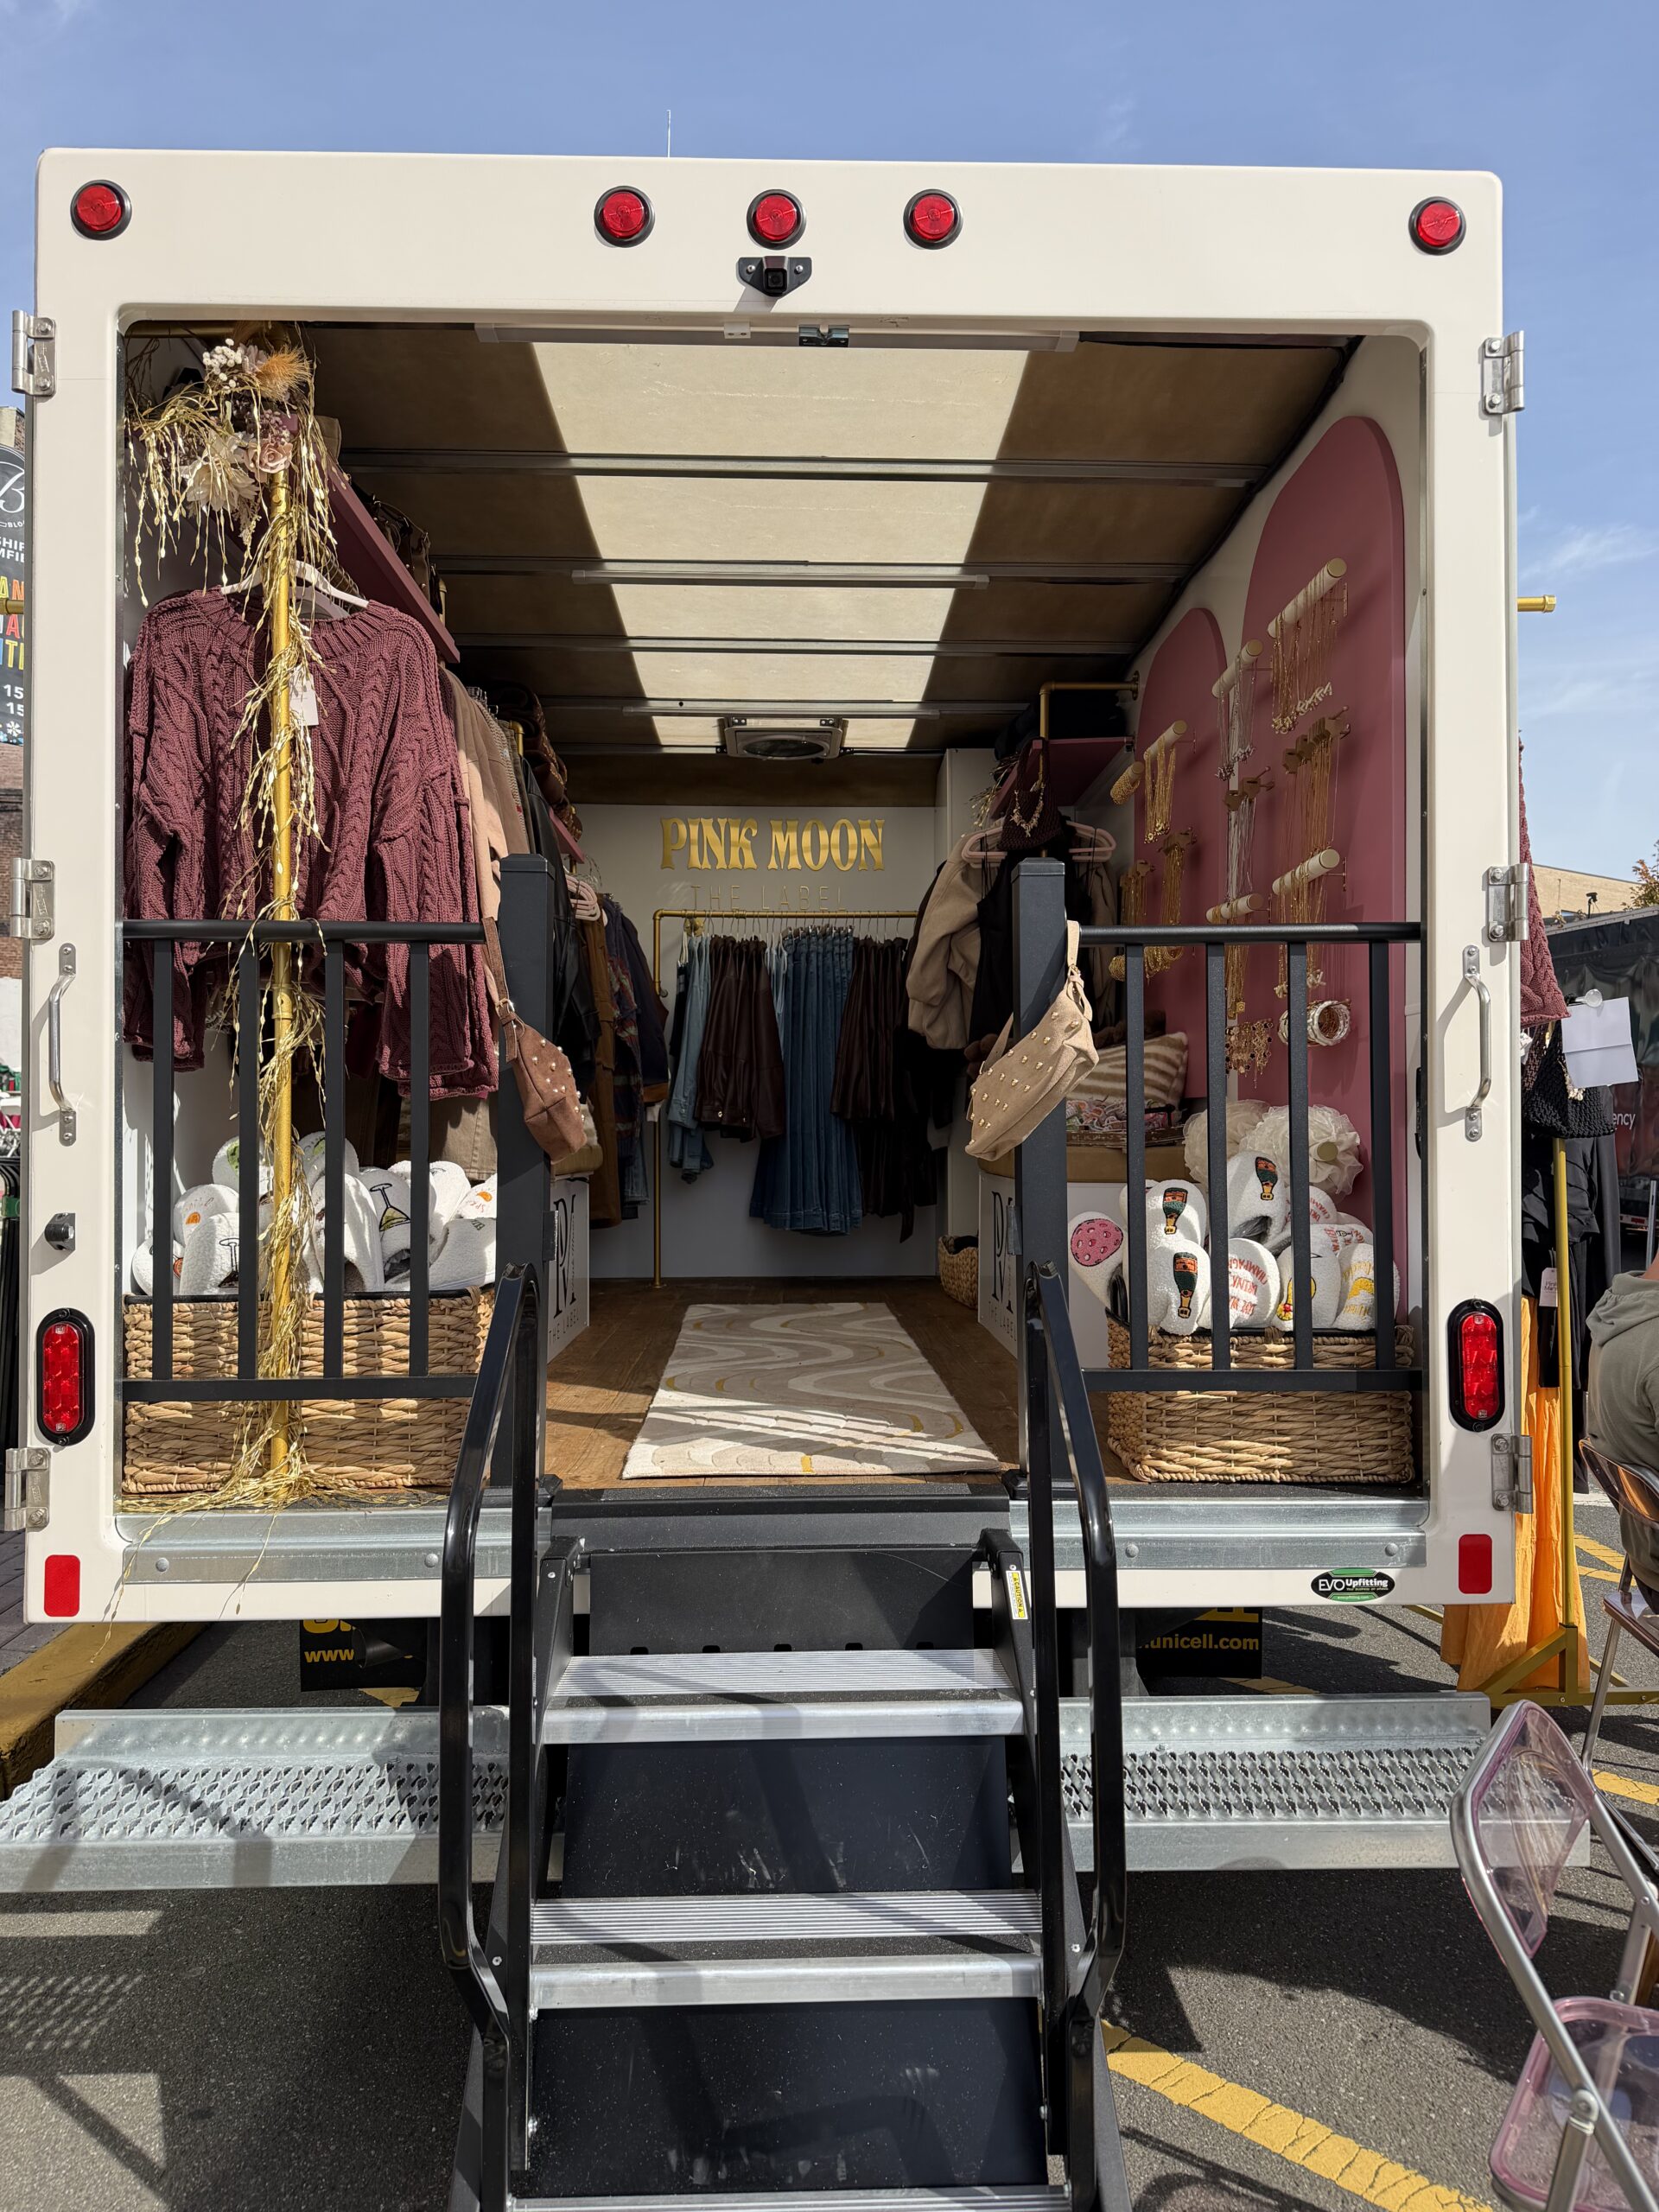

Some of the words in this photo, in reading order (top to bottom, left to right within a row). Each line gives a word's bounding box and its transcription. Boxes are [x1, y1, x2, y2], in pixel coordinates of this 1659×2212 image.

[660, 817, 758, 871] PINK
[766, 817, 886, 872] MOON
[690, 885, 741, 910] THE
[761, 885, 848, 912] LABEL
[1014, 1581, 1023, 1607] CAUTION
[1319, 1579, 1345, 1591] EVO
[1345, 1578, 1389, 1588] Upfitting
